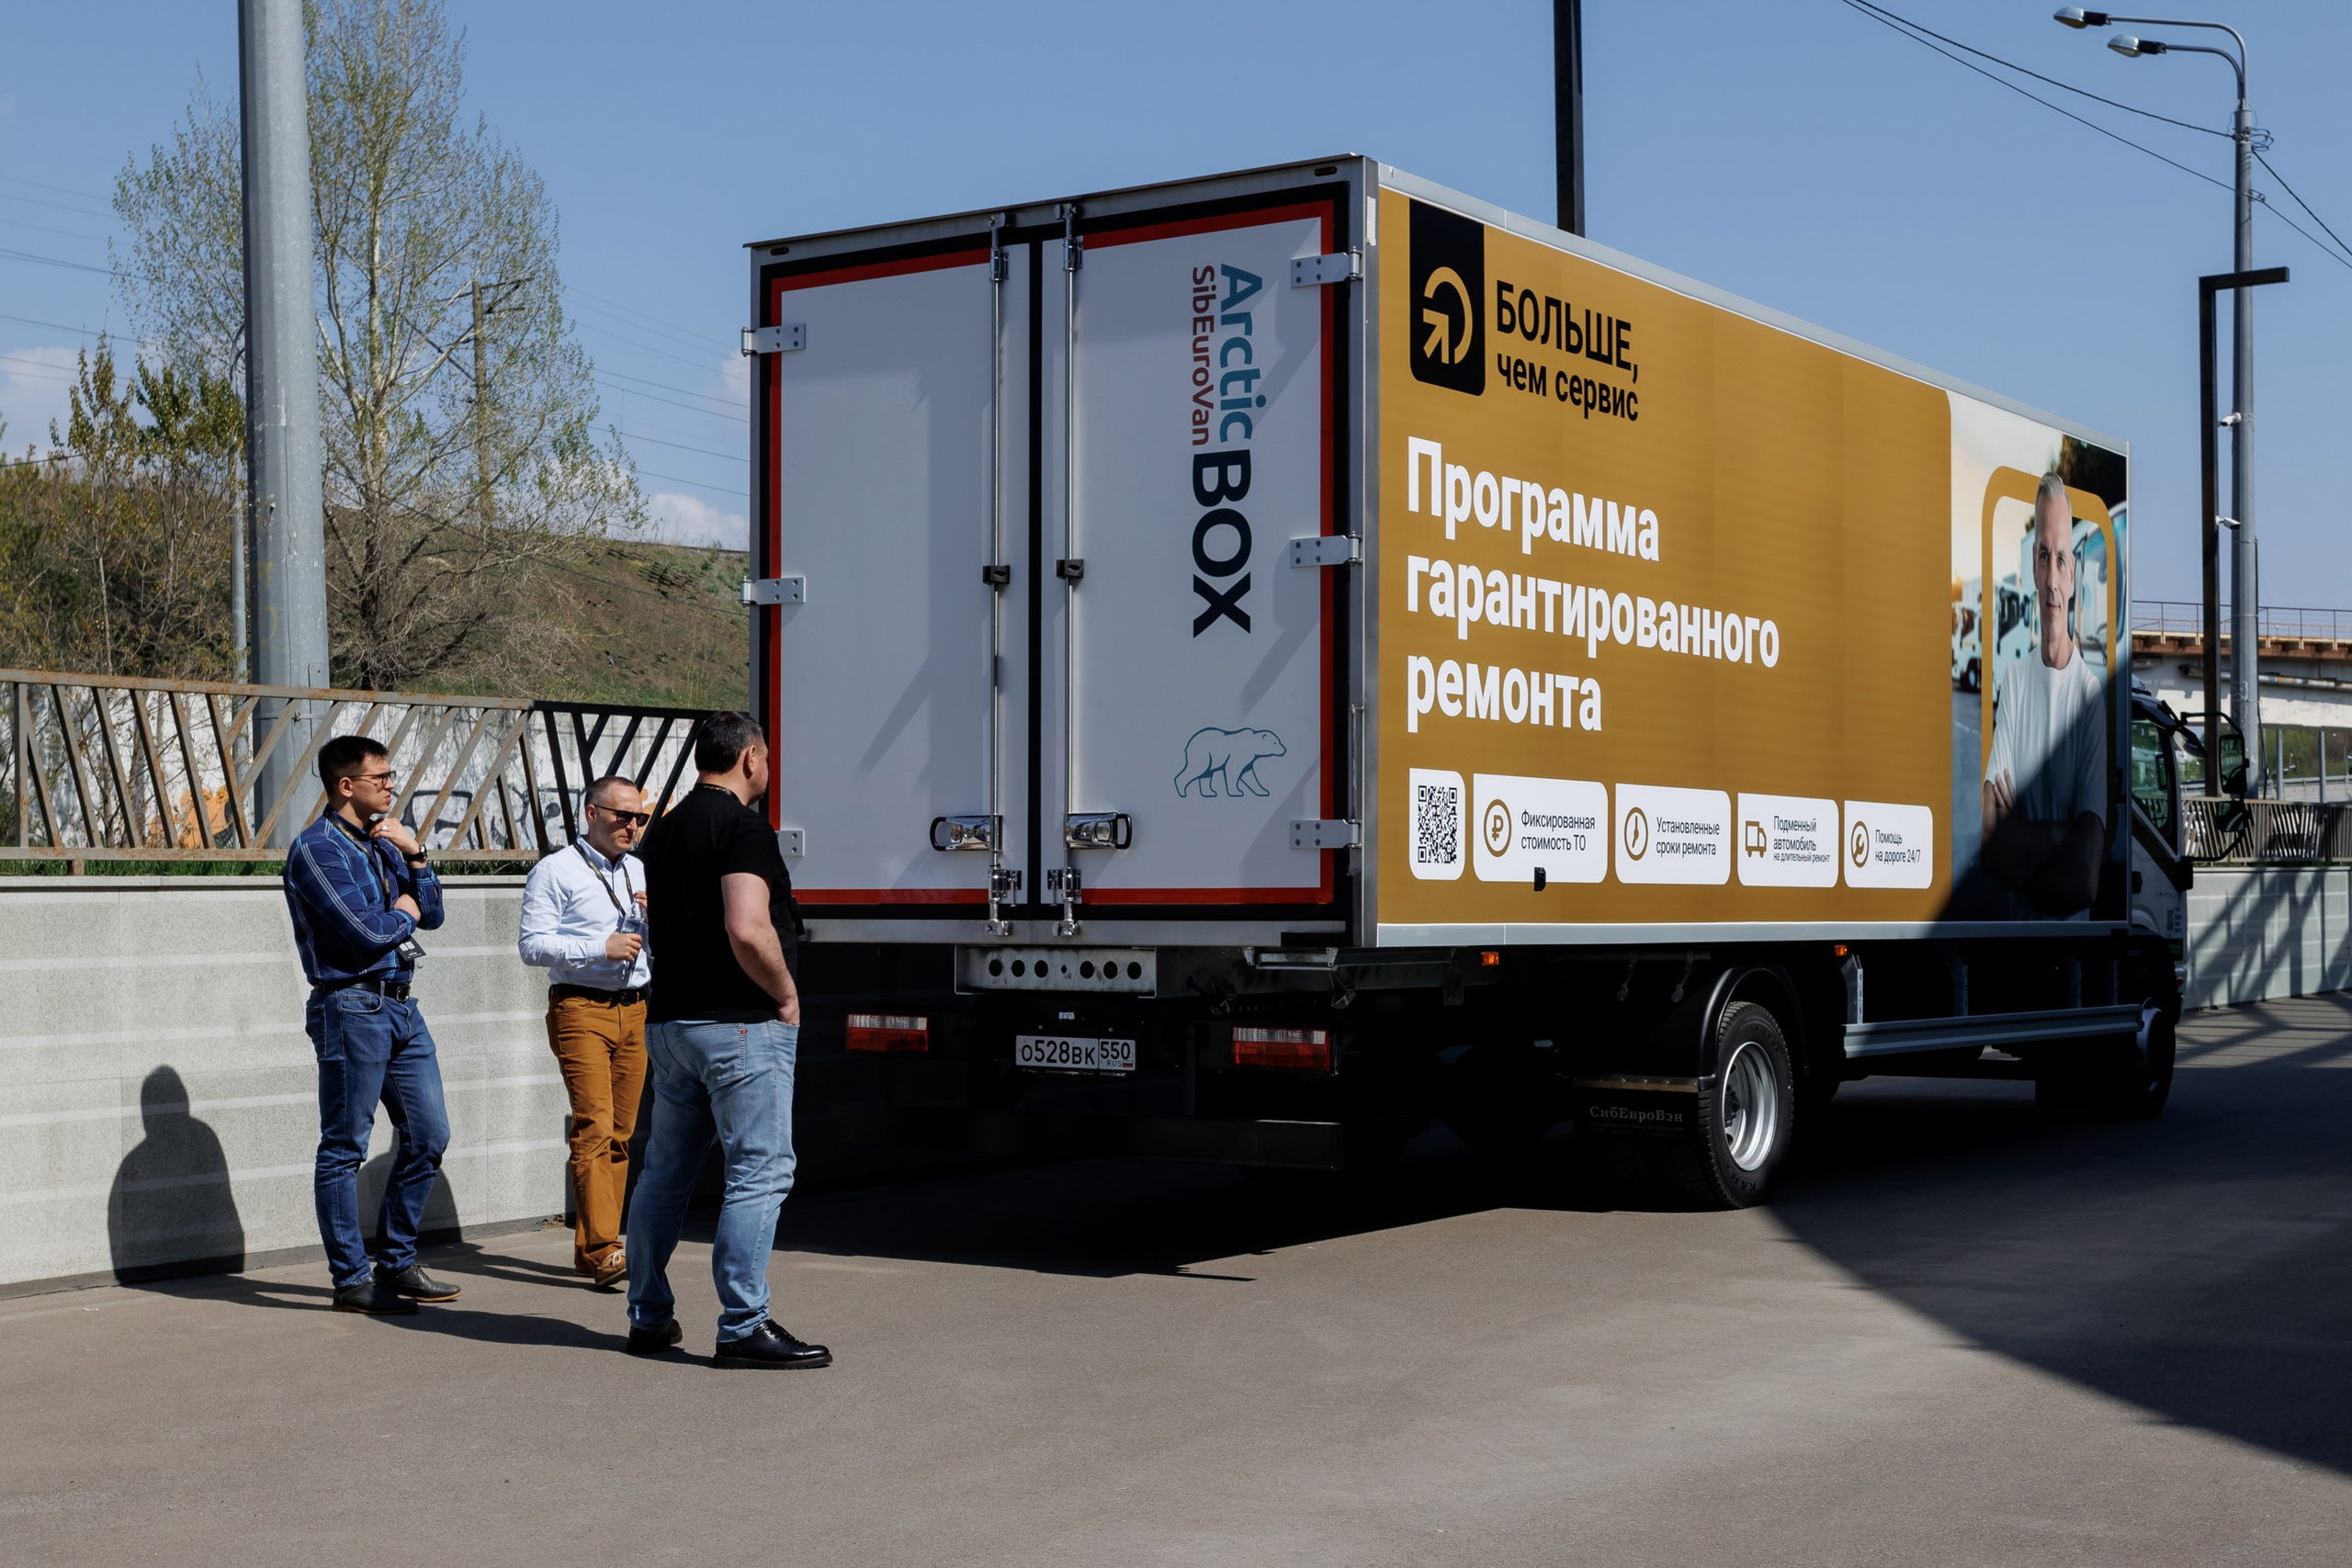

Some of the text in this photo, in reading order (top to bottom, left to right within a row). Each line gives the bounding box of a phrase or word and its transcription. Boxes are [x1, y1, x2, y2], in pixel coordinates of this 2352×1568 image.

[1497, 279, 1639, 384] БОЛЬШЕ,
[1192, 265, 1217, 446] SibEuroVan
[1497, 352, 1639, 422] чем сервис
[1408, 435, 1660, 562] Программа
[1408, 555, 1781, 669] гарантированного
[1408, 655, 1602, 733] ремонта
[1521, 809, 1596, 832] Фиксированная
[1656, 817, 1720, 835] Установленные
[1773, 815, 1816, 833] Подменный
[1521, 834, 1587, 852] стоимость ТО
[1773, 836, 1816, 852] автомобиль
[1875, 829, 1903, 846] Помощь
[1656, 840, 1716, 858] сроки ремонта
[1773, 852, 1781, 862] на
[1875, 849, 1921, 865] на дороге 24/7
[1100, 1041, 1131, 1060] 550
[1106, 1059, 1122, 1067] RUS
[1589, 1106, 1683, 1123] СибЕвроВэн
